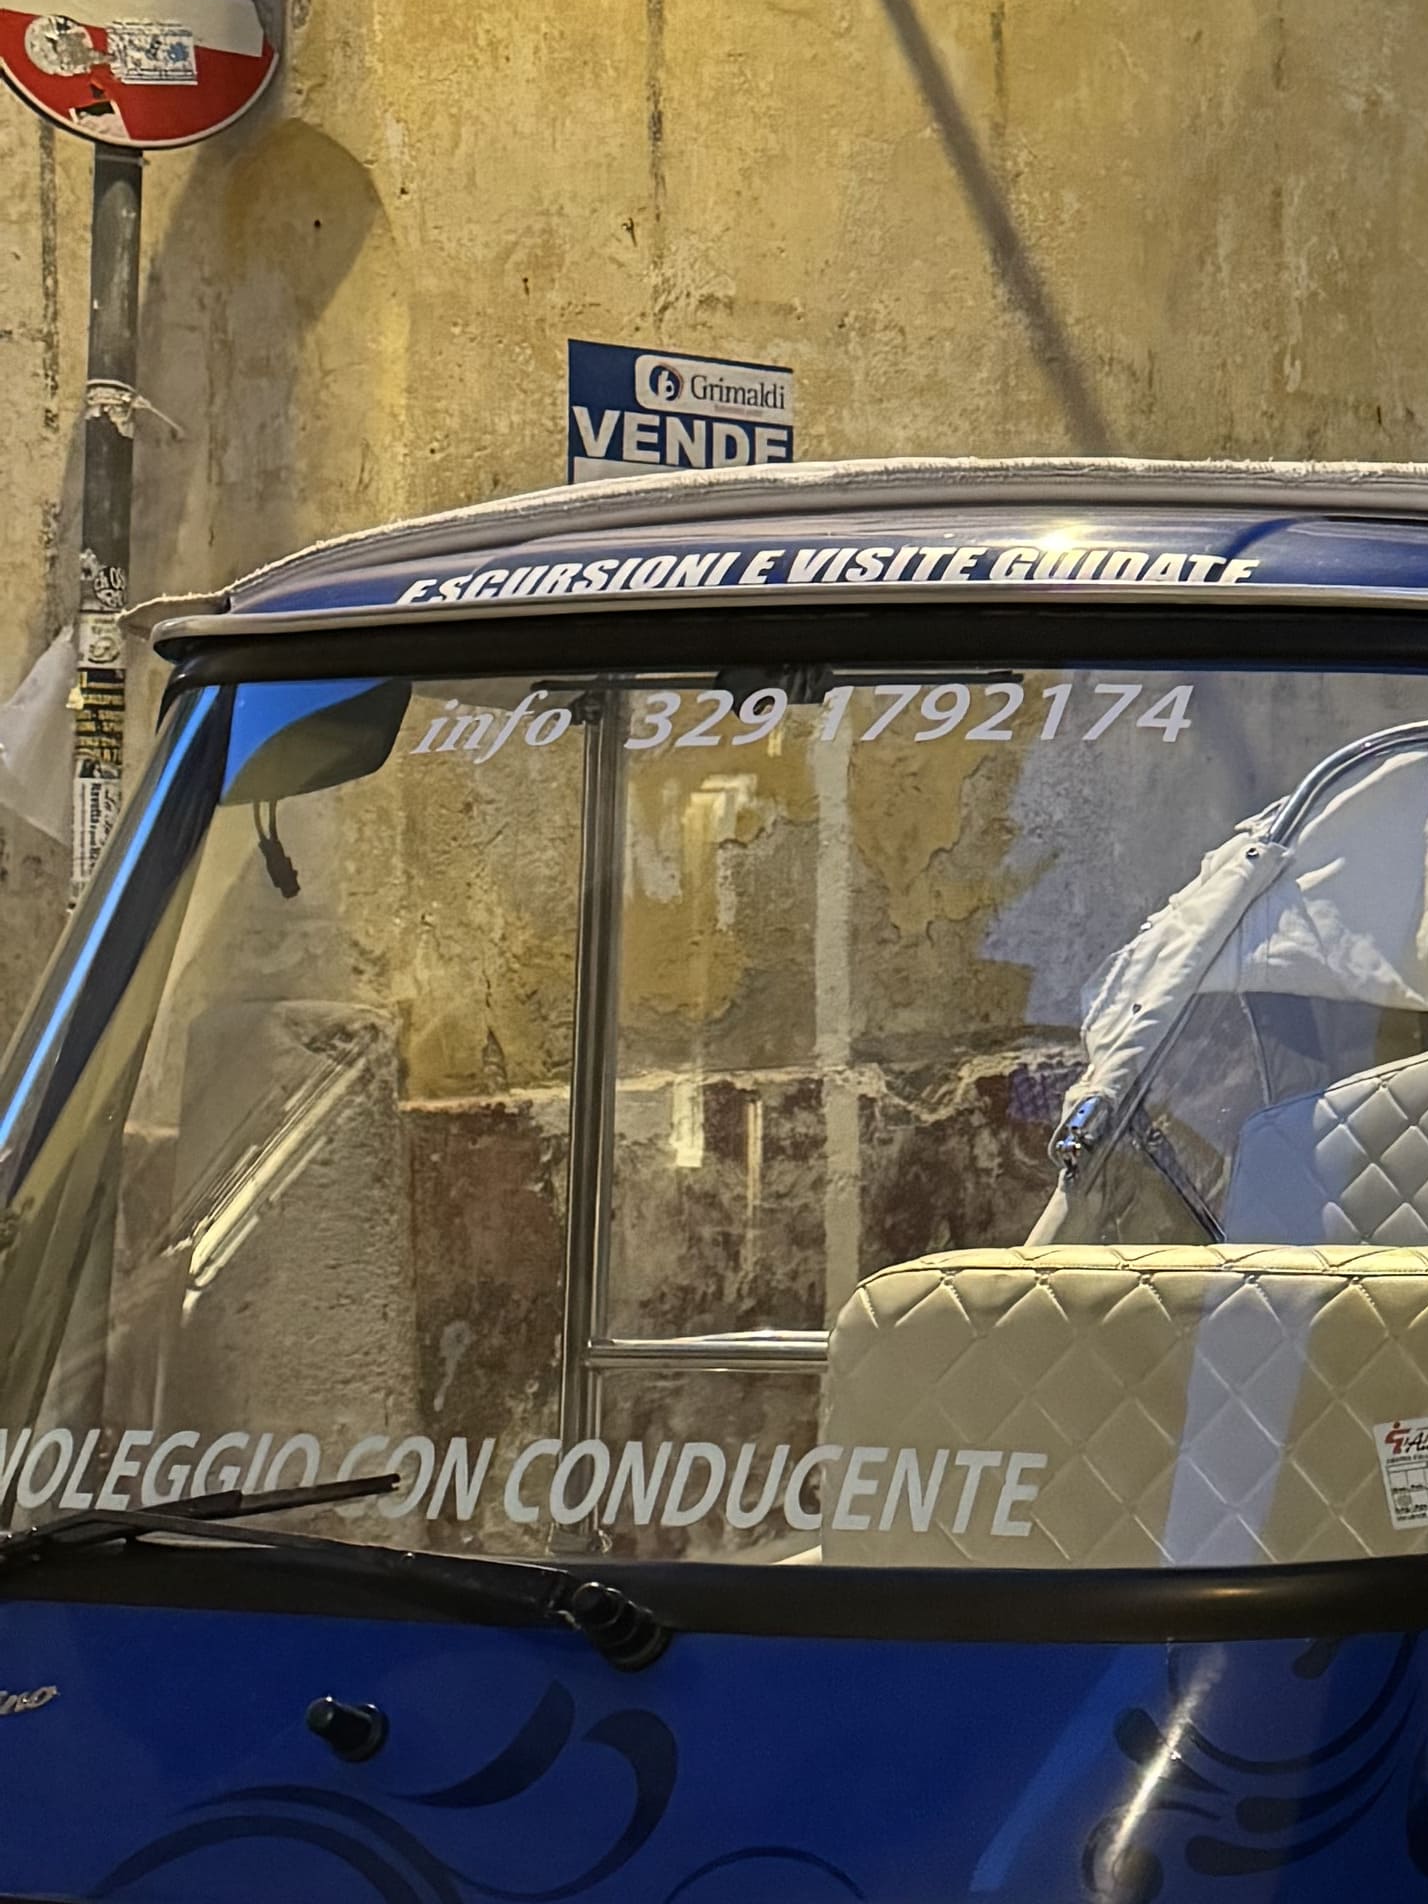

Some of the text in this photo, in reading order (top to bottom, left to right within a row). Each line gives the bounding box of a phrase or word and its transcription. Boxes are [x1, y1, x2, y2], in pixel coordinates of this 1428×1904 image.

[691, 374, 785, 410] Grimaldi
[571, 405, 788, 469] VENDE
[396, 545, 1260, 606] ESCURSIONI E VISITE GUIDATE
[410, 682, 1194, 765] info 329 1792174
[0, 1427, 1048, 1537] NOLEGGIO CON CONDUCENTE
